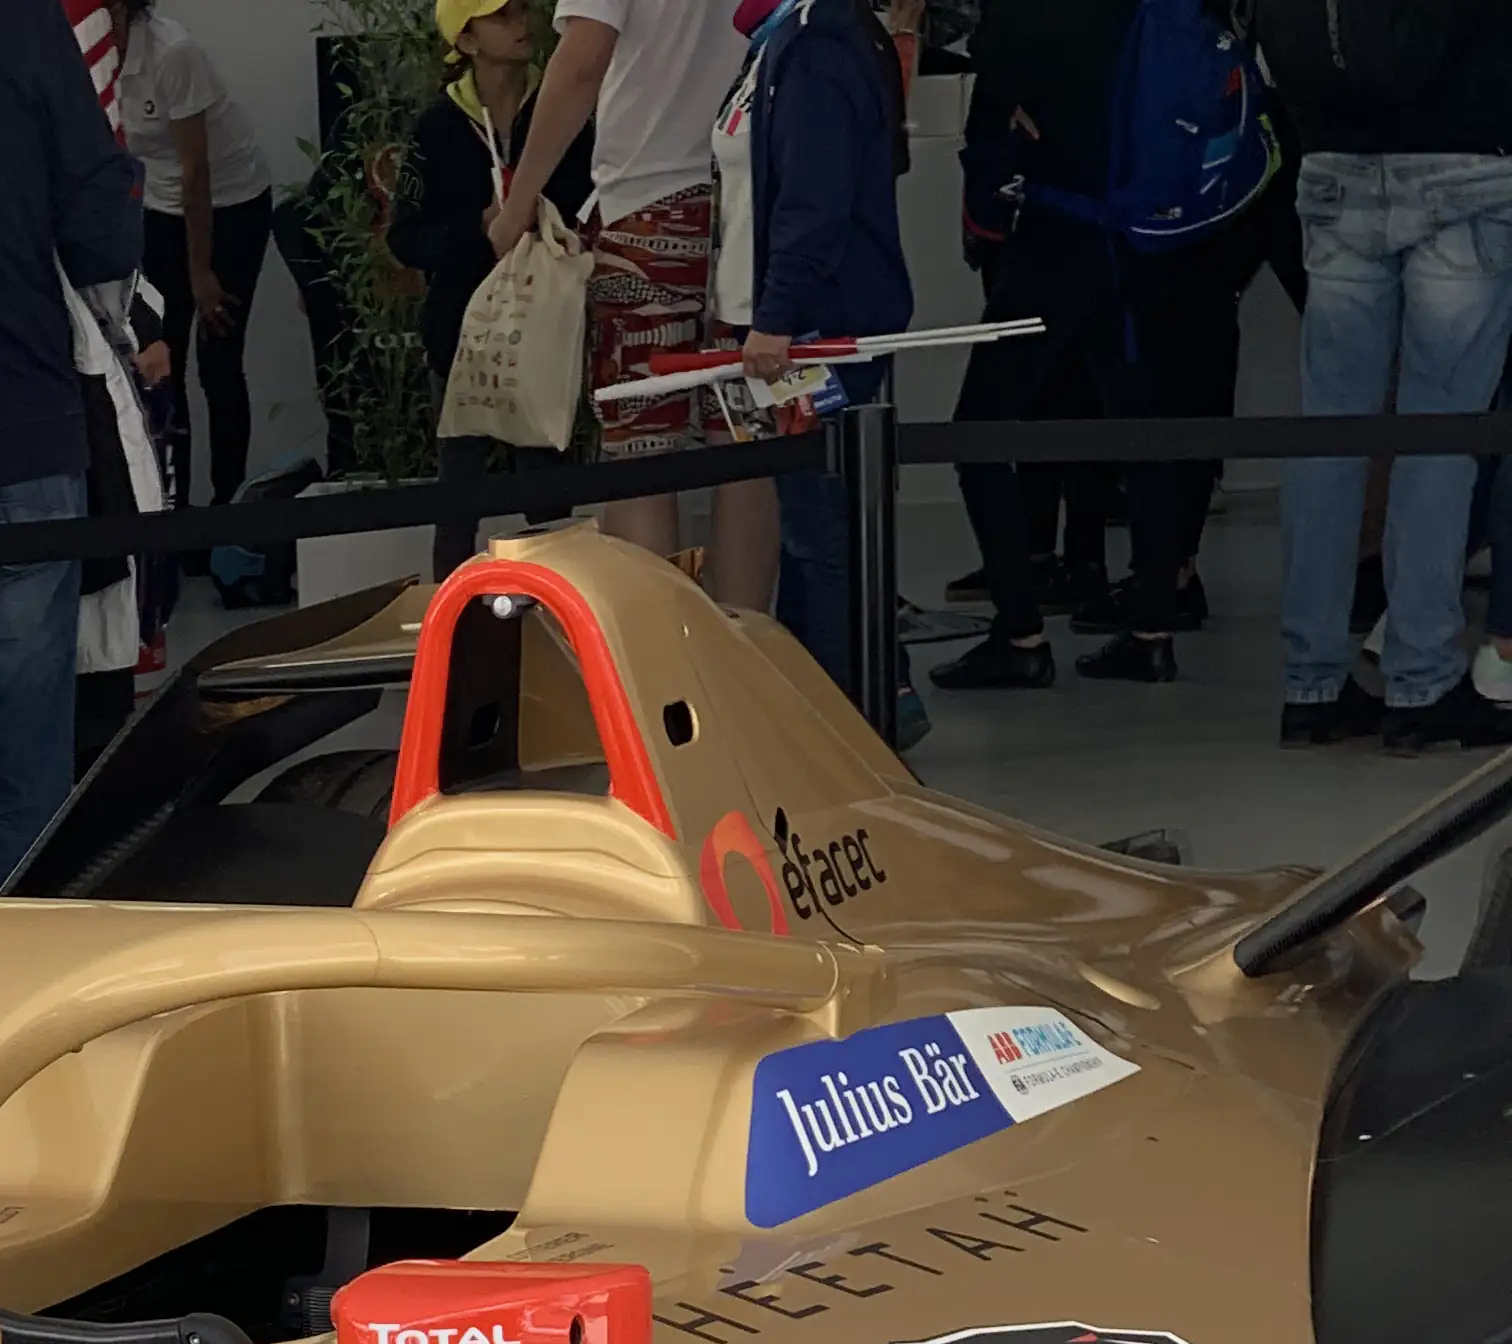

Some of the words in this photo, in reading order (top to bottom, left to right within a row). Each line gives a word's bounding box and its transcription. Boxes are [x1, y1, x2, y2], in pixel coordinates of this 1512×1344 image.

[782, 828, 887, 920] efacec
[776, 1071, 913, 1178] Julius
[898, 1042, 980, 1116] Bär
